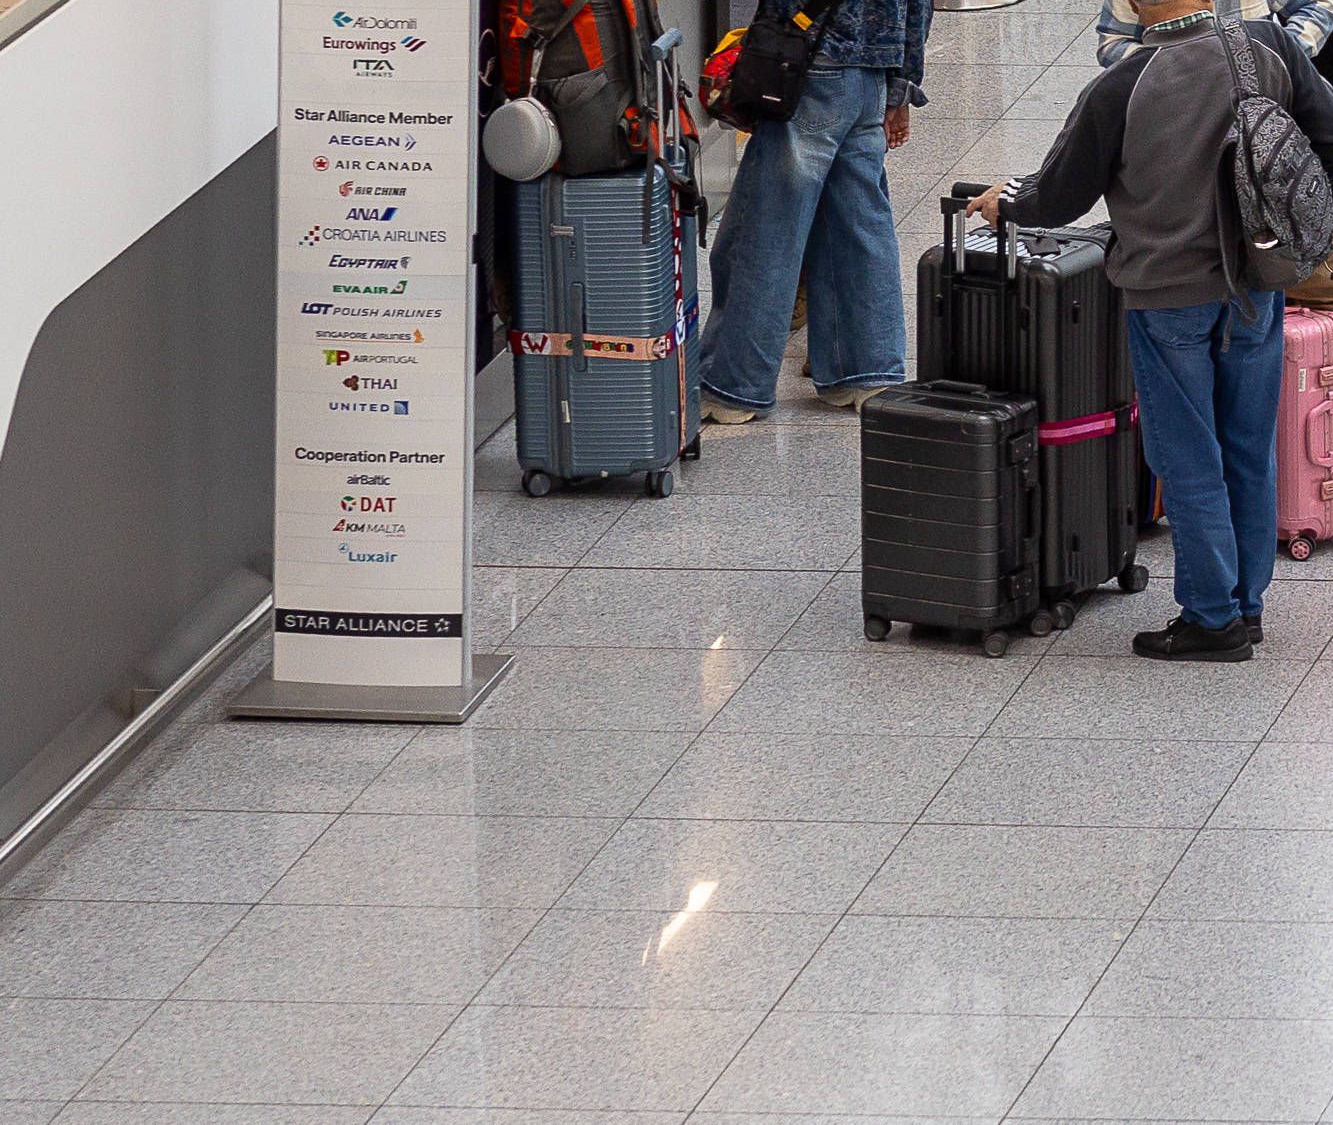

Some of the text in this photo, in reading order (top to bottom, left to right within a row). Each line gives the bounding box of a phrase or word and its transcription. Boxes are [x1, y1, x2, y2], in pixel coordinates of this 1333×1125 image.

[323, 37, 396, 54] Eurowings
[353, 59, 395, 70] ITA
[295, 109, 453, 125] Star Alliance Member
[328, 136, 400, 147] AEGEAN
[335, 161, 433, 171] AIR CANADA
[354, 187, 407, 196] AIR CHINA
[346, 208, 380, 220] ANA
[322, 228, 447, 243] CROATIA AIRLINES
[328, 255, 399, 269] EGYPTAIR
[301, 303, 442, 318] LOT POLISH AIRLINES
[361, 378, 398, 390] THAI
[329, 402, 389, 412] UNITED
[295, 448, 446, 464] Cooperation Partner
[346, 475, 391, 486] airBaltic
[360, 497, 397, 512] DAT
[345, 523, 406, 533] KM MALTA
[348, 552, 398, 563] Luxair
[284, 615, 428, 632] STAR ALLIANCE
